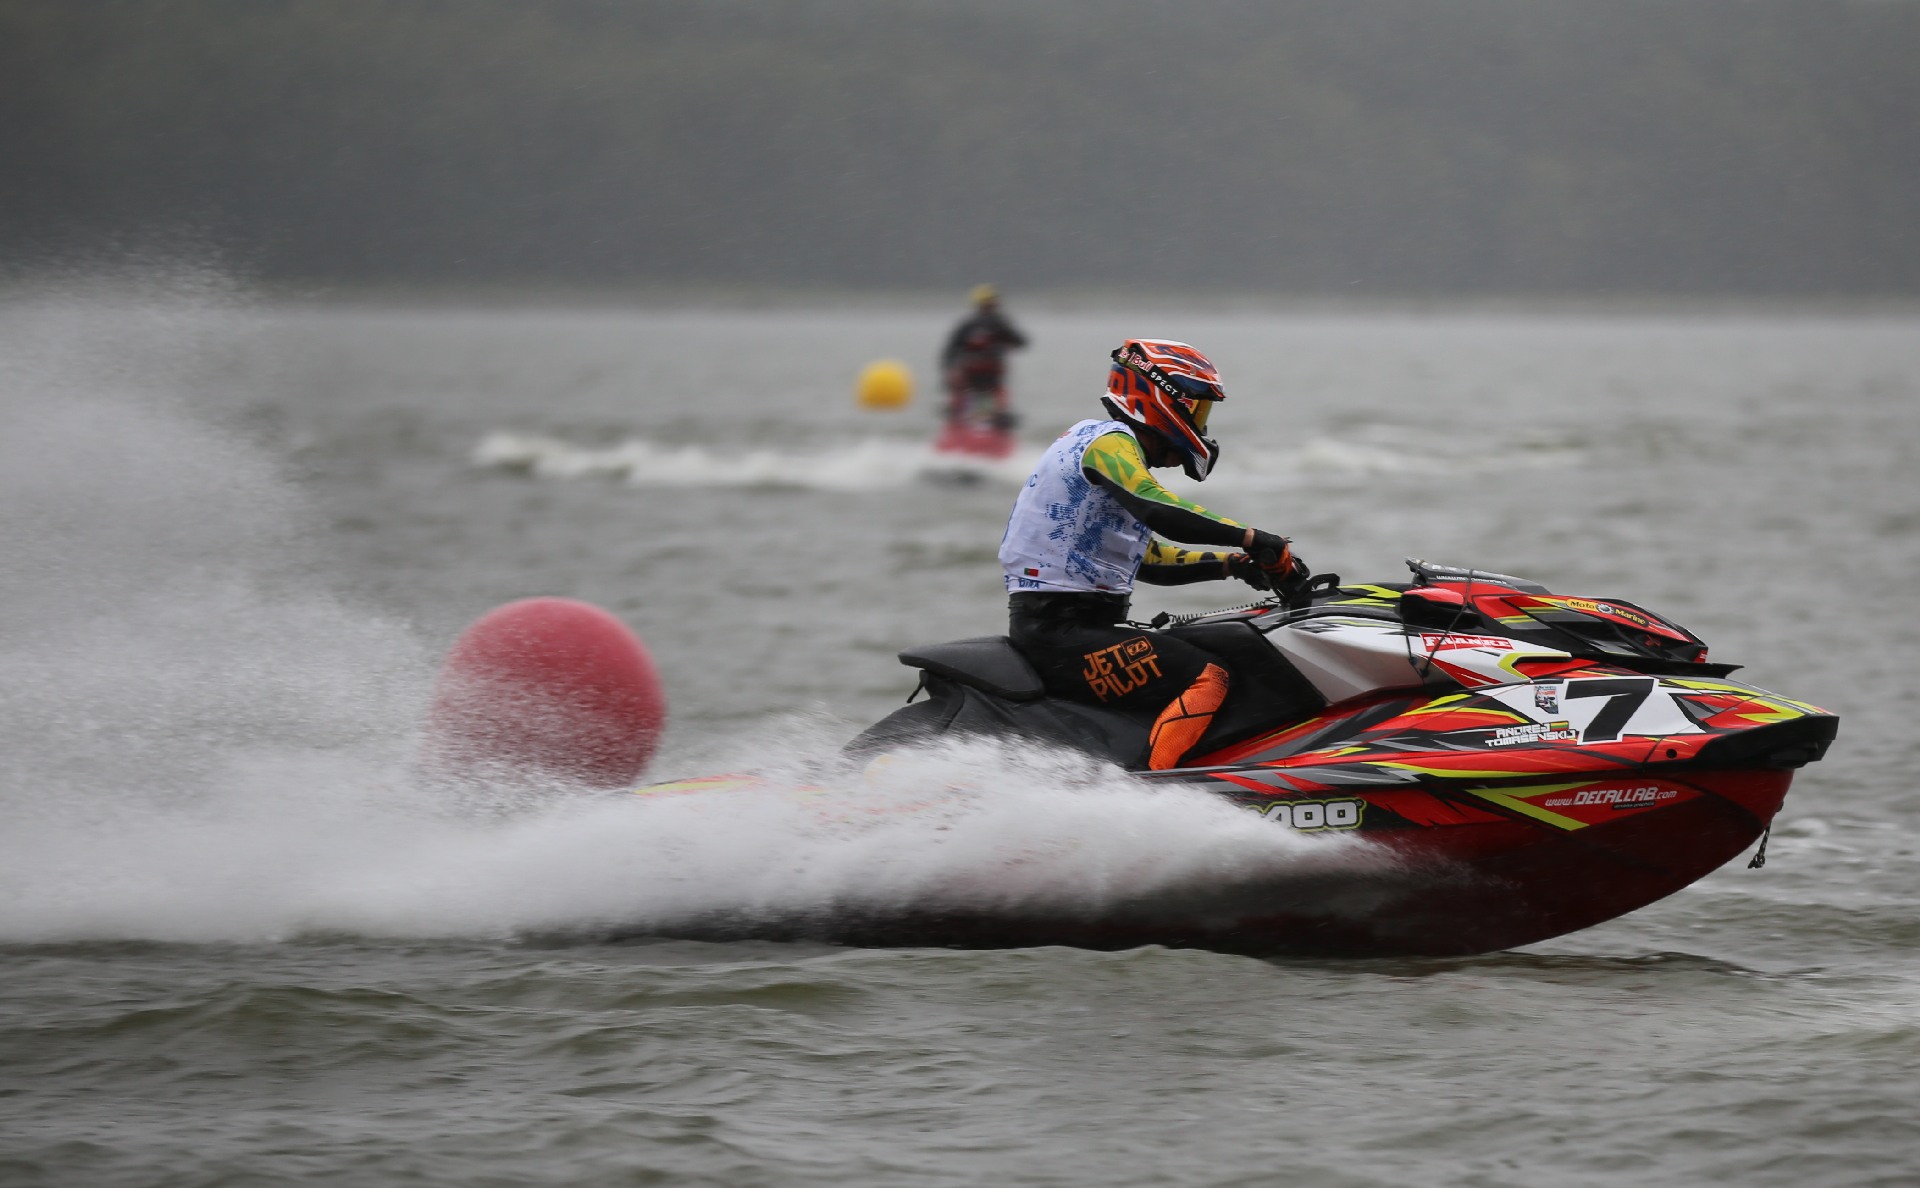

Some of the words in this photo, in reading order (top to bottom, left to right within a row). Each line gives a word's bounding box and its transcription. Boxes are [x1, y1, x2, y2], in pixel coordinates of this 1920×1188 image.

[1131, 354, 1154, 373] Bull
[1150, 371, 1178, 396] SPECT
[1570, 600, 1596, 610] Moto
[1615, 608, 1646, 625] Marine
[1083, 644, 1125, 681] JET
[1089, 654, 1163, 702] PILOT
[1565, 678, 1655, 742] 7
[1496, 722, 1551, 738] ANDREJ
[1545, 787, 1677, 806] www.DECALLAB.com
